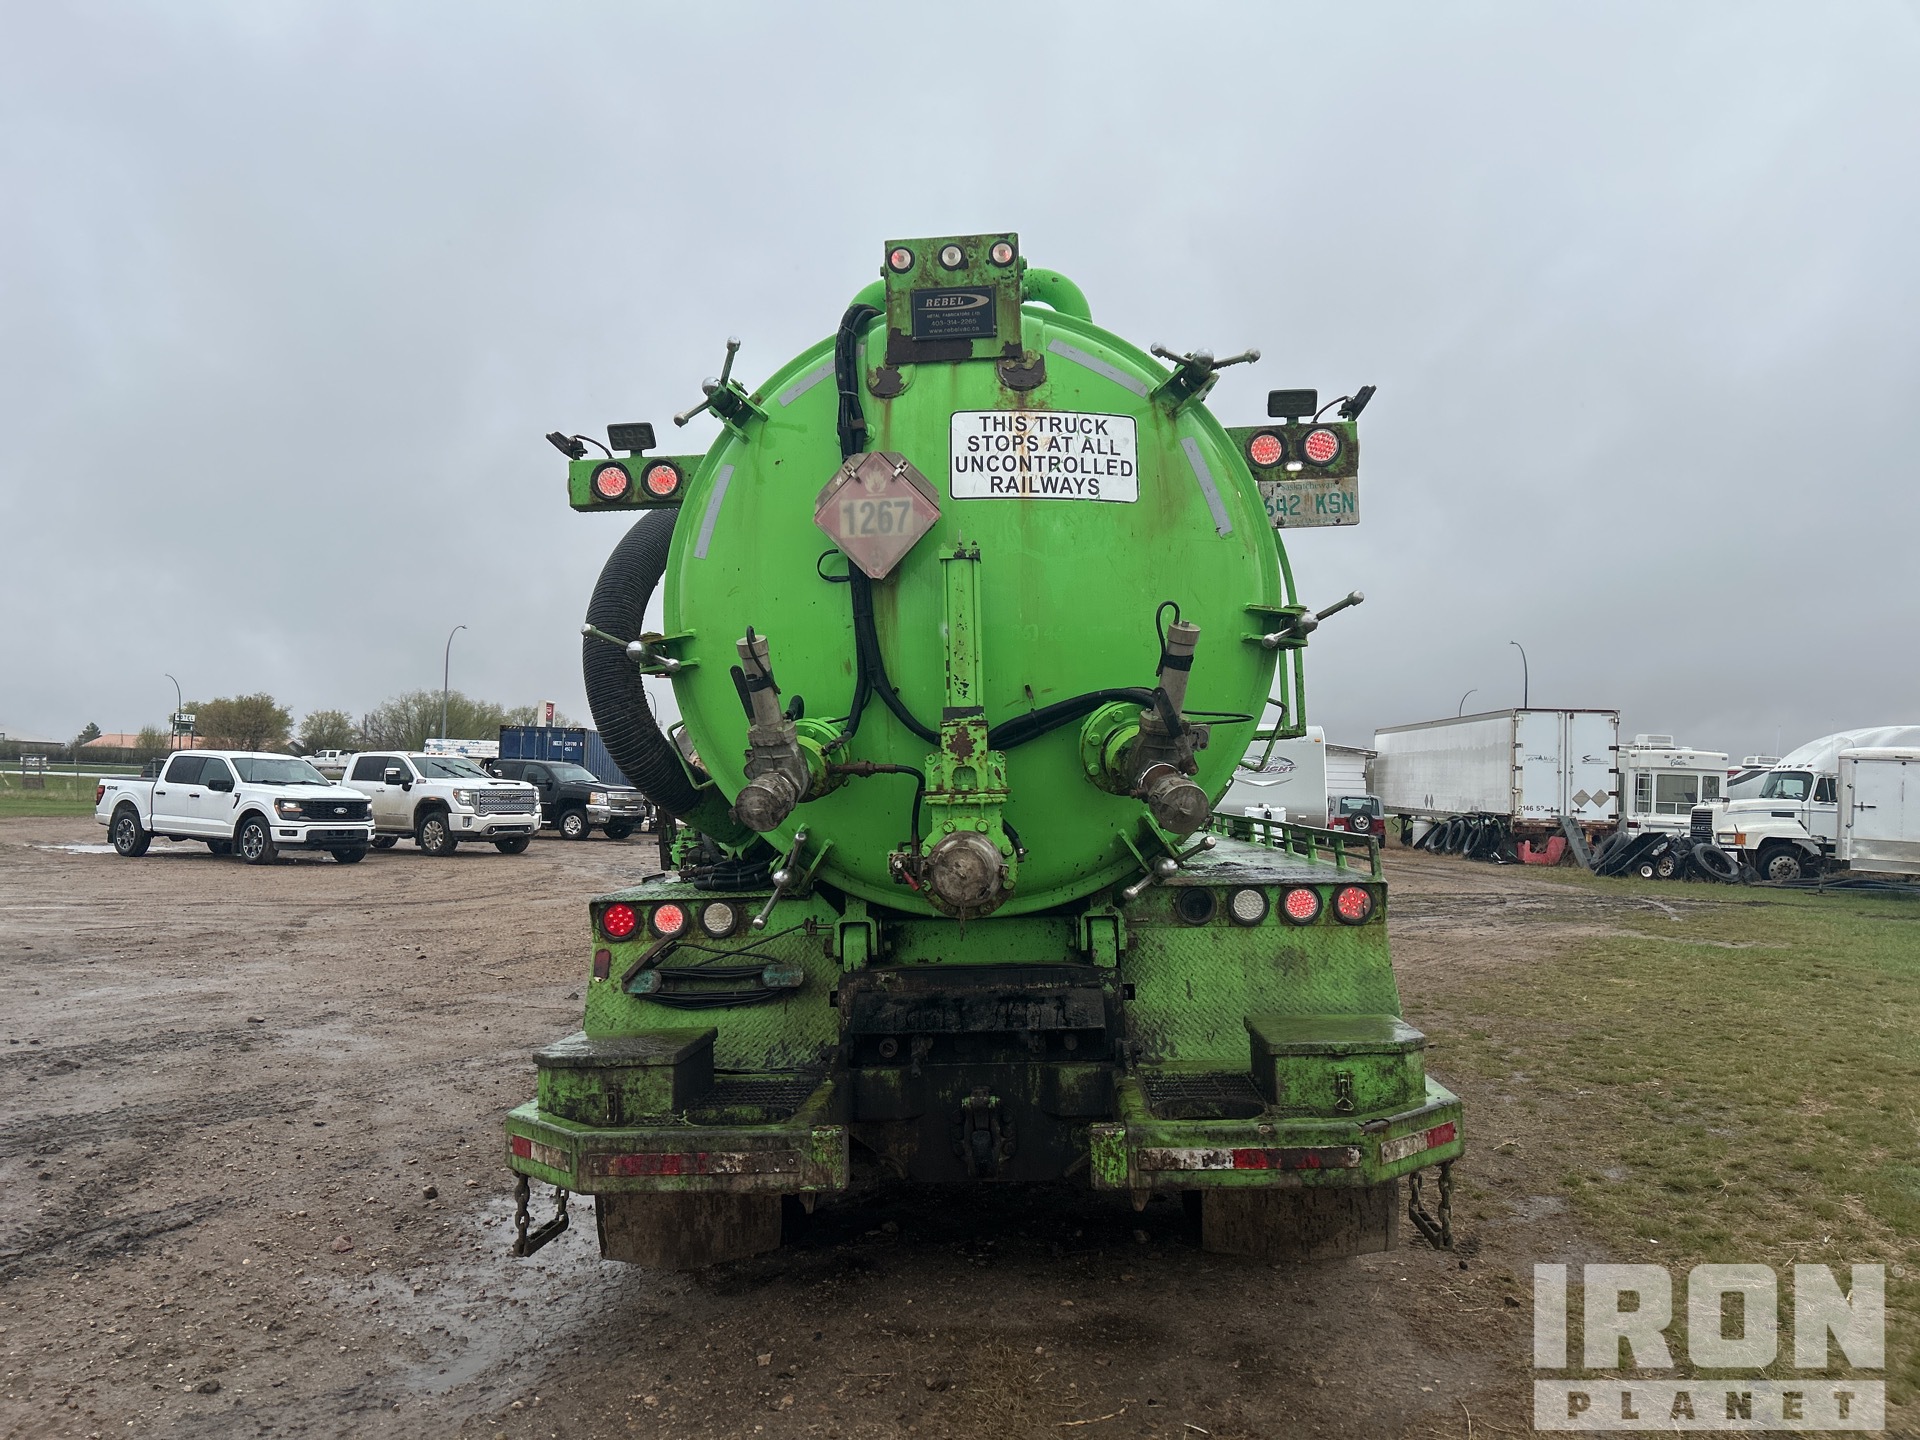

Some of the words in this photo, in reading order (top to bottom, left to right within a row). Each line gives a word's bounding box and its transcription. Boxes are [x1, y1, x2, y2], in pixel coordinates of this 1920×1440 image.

[926, 297, 964, 307] REBEL
[979, 416, 1027, 432] THIS
[1035, 416, 1109, 436] TRUCK
[967, 435, 1039, 452] STOPS
[1047, 436, 1073, 453] AT
[1081, 438, 1121, 456] ALL
[955, 455, 1133, 477] UNCONTROLLED
[990, 475, 1101, 496] RAILWAYS
[1281, 482, 1337, 491] Saskatchewan
[1315, 491, 1354, 514] KSN
[842, 500, 911, 535] 1267
